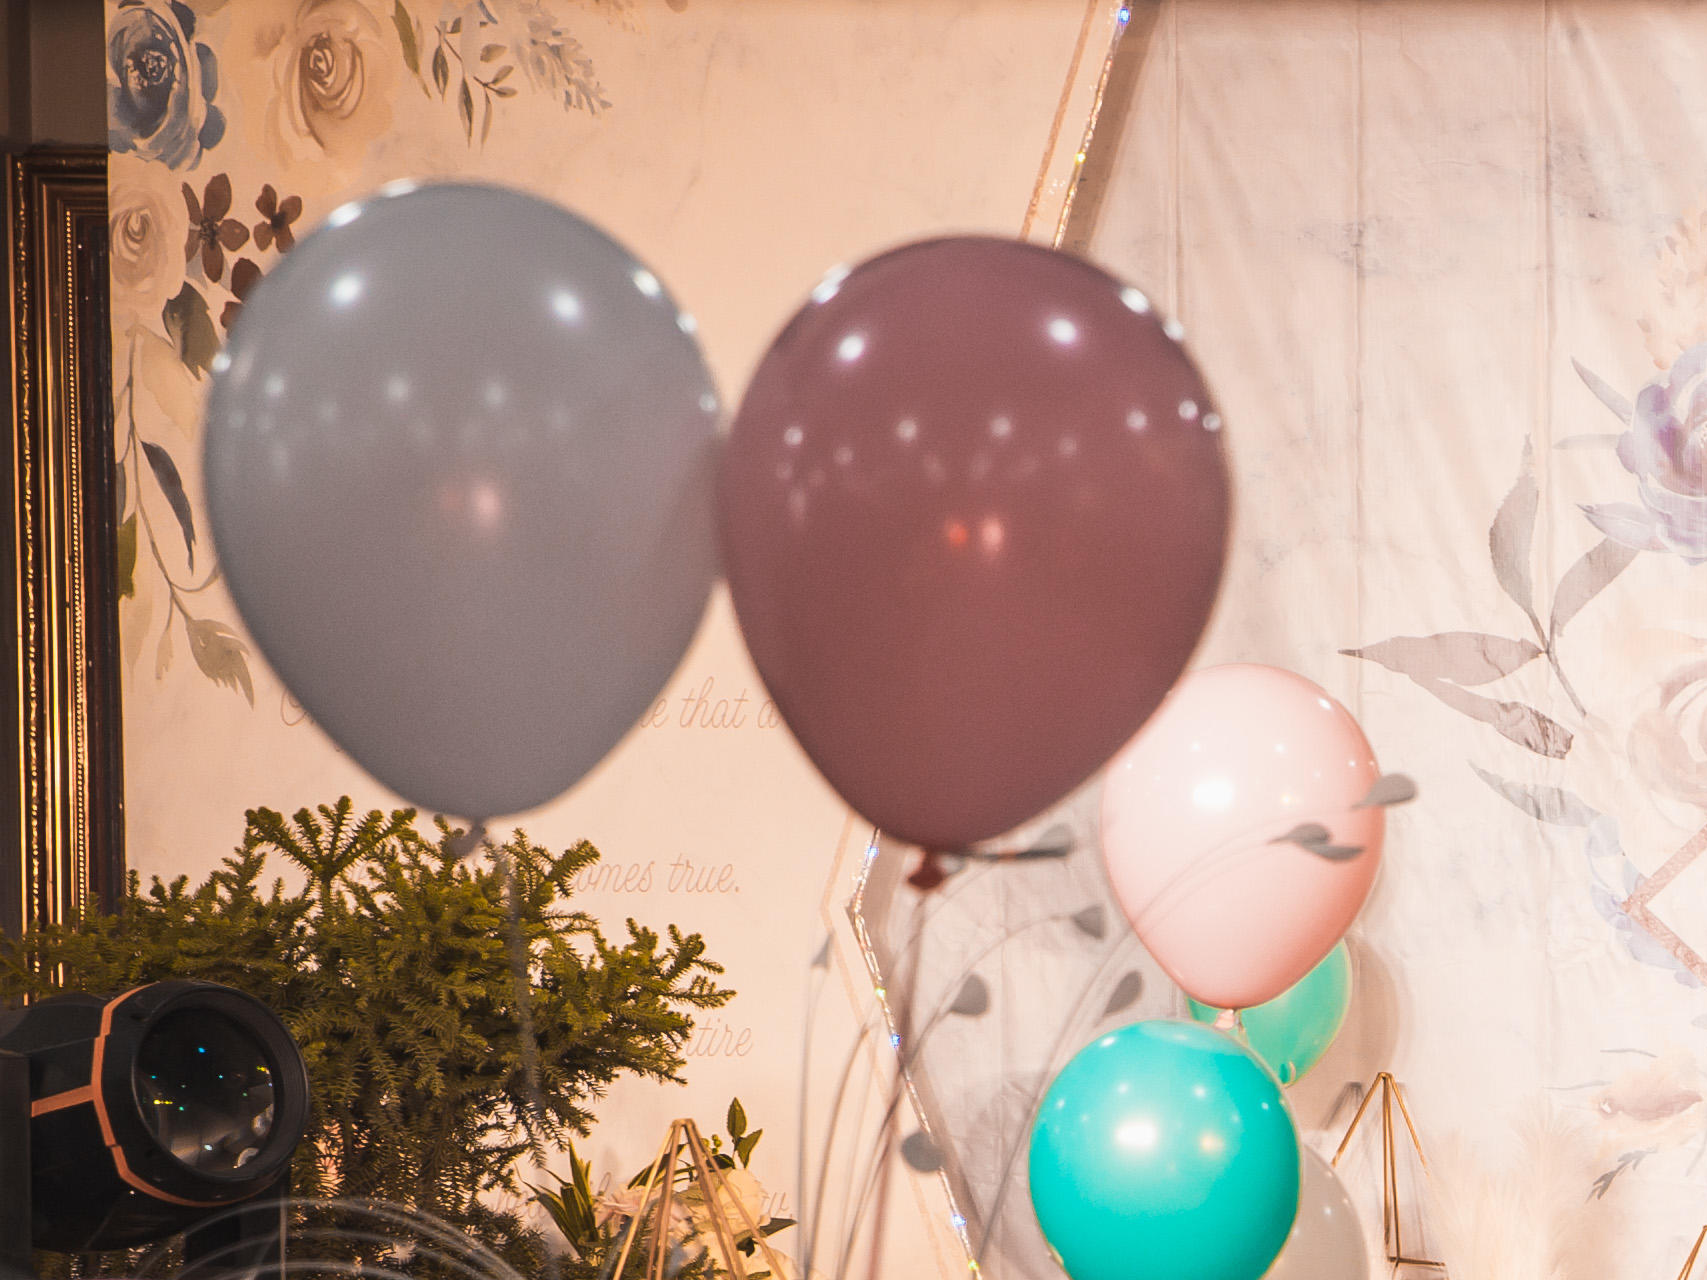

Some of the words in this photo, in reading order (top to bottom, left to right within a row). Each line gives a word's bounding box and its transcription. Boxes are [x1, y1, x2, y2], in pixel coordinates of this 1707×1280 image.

[679, 677, 748, 729] that
[573, 858, 656, 893] omes
[668, 853, 740, 893] true.
[684, 1017, 754, 1057] tire
